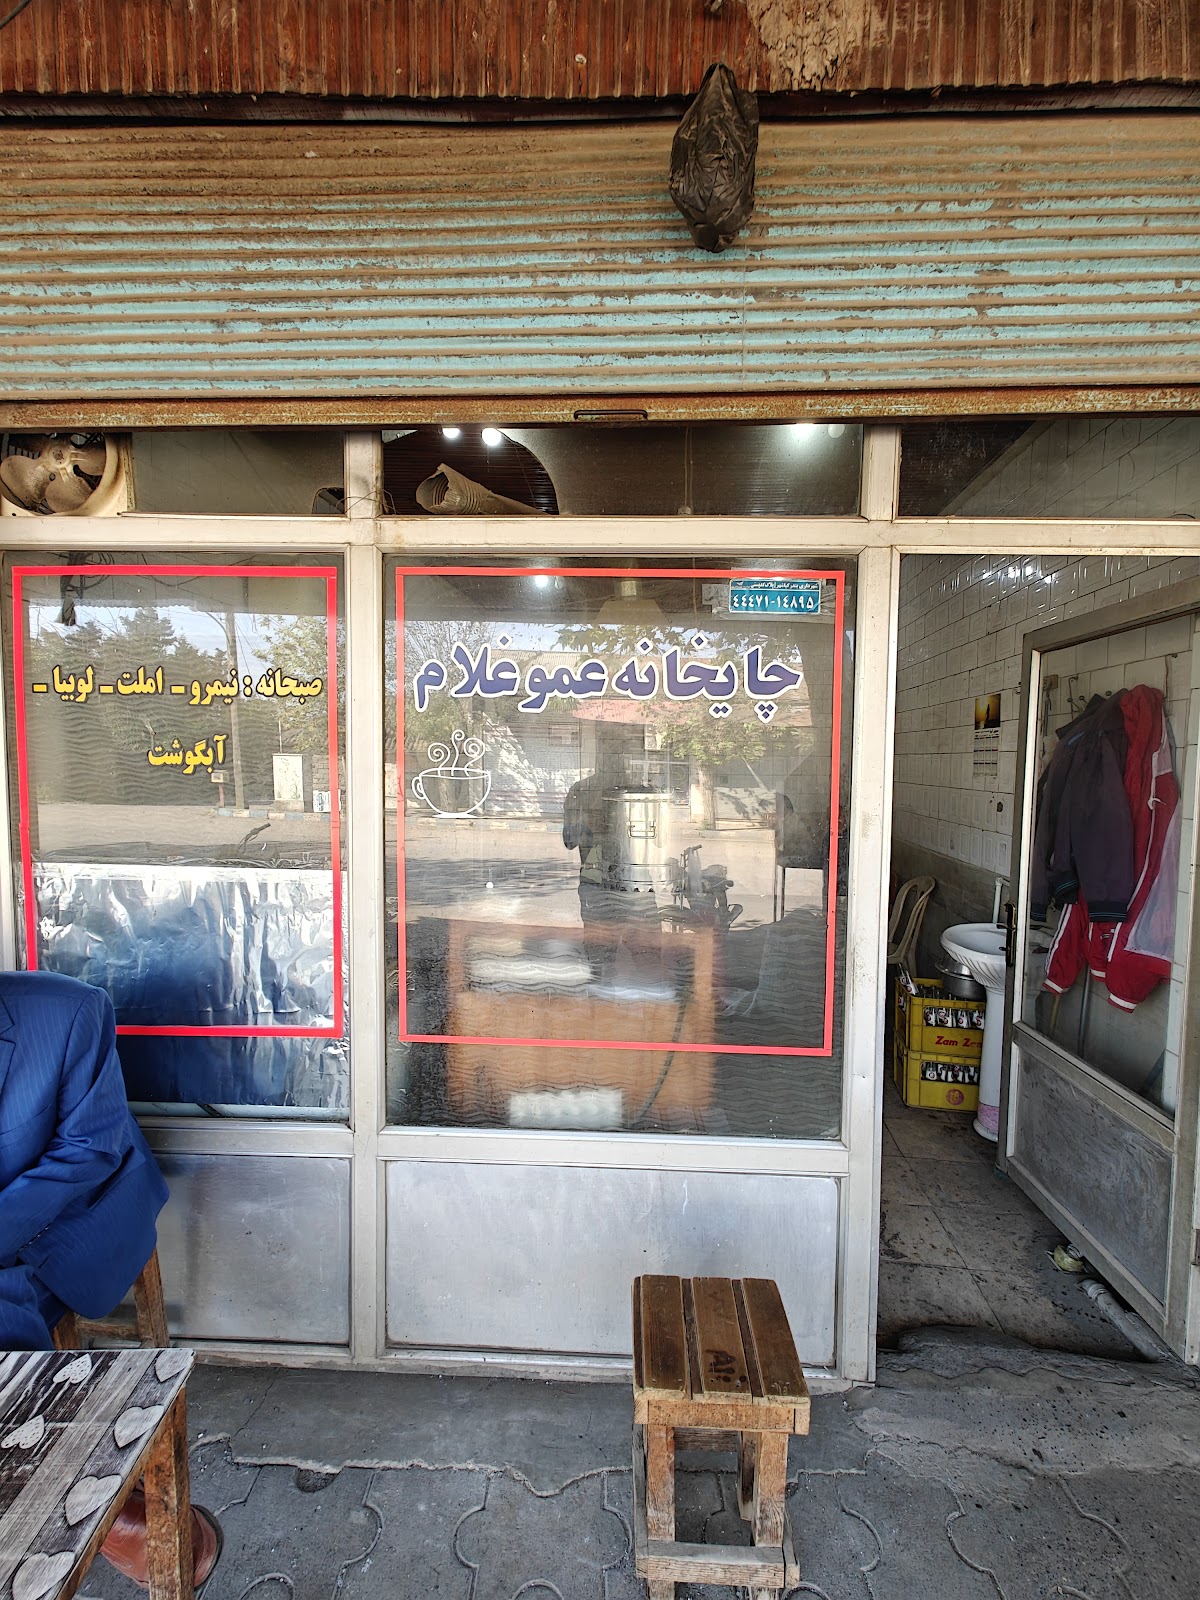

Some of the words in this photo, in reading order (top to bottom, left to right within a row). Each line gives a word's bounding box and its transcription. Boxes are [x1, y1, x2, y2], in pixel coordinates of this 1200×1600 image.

[53, 665, 93, 702] لوبیا
[117, 666, 163, 695] املت
[190, 668, 238, 705] نیمرو
[612, 632, 803, 722] چایخانه
[148, 734, 226, 774] آبگوشت
[935, 1036, 958, 1047] Zam
